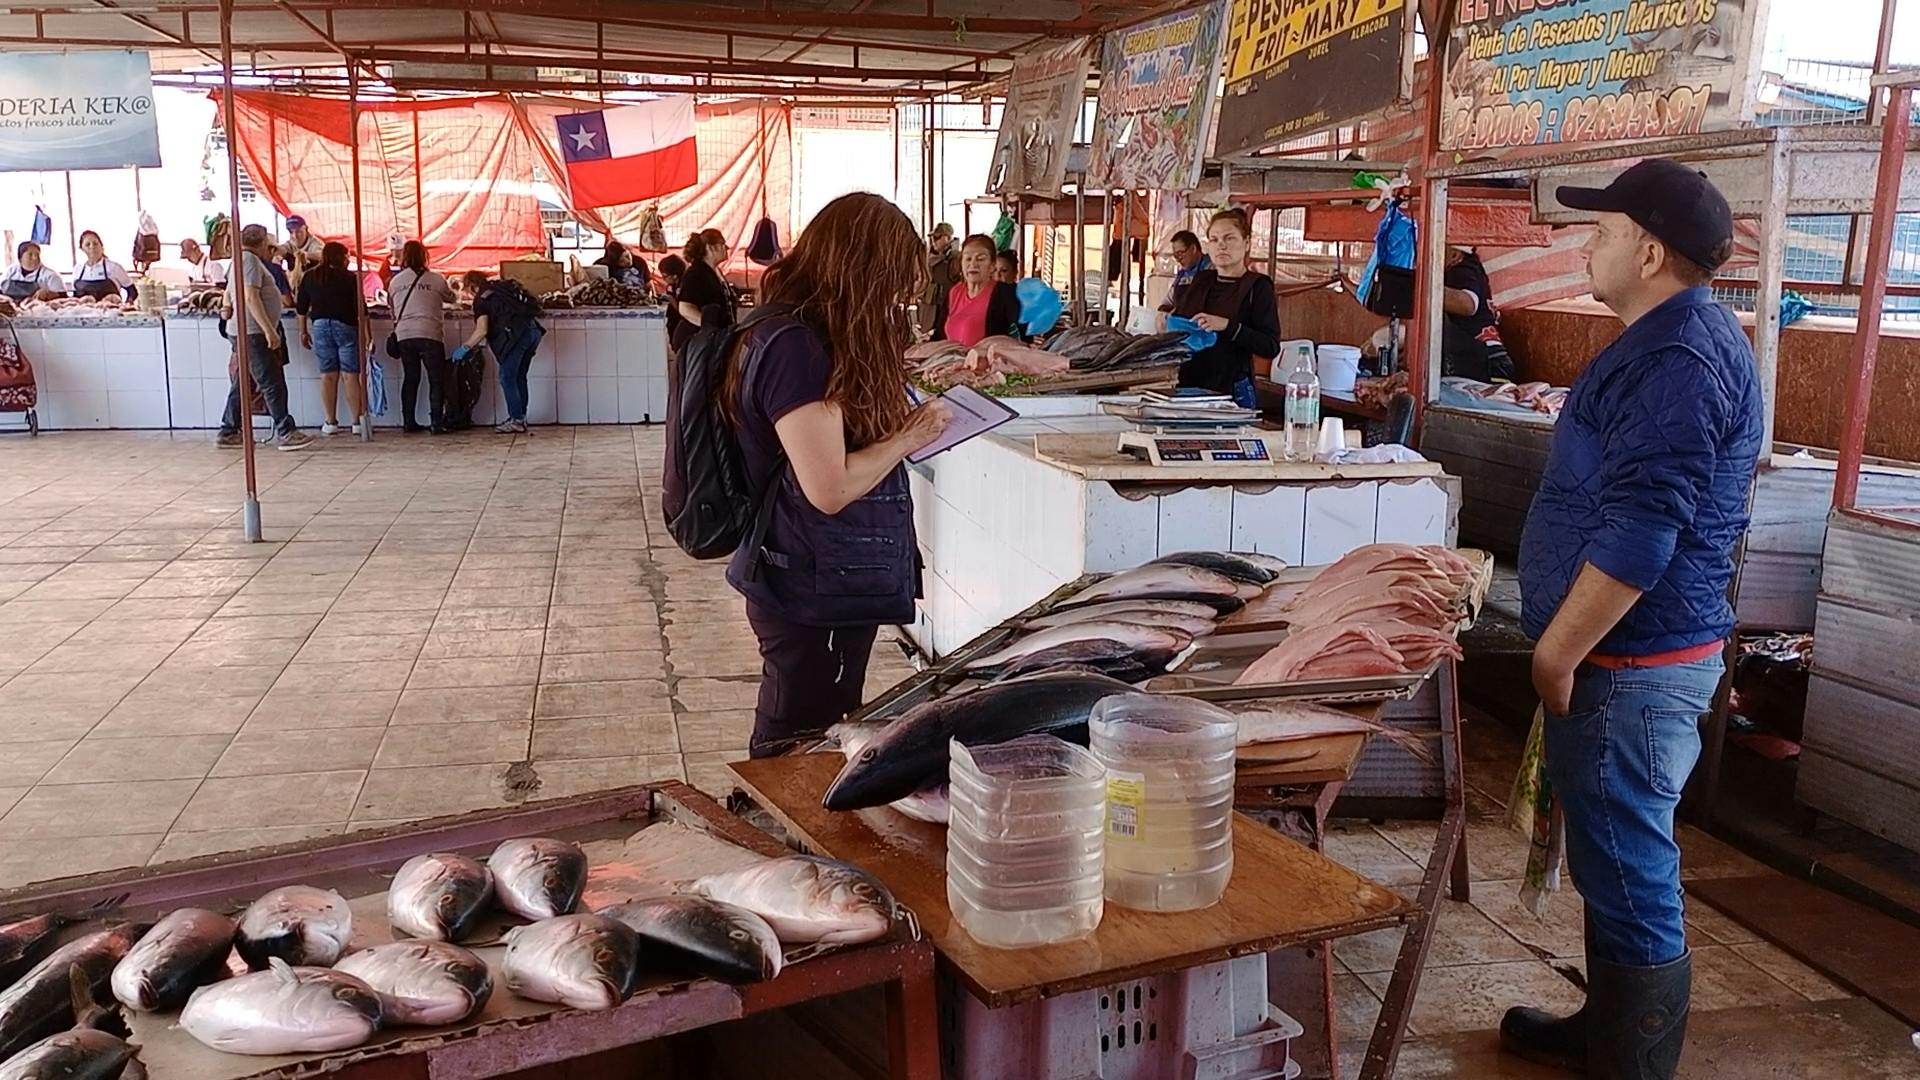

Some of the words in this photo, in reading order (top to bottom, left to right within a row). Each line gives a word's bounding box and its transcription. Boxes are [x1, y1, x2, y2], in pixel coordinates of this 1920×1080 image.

[1308, 41, 1329, 60] JUREL
[1350, 15, 1389, 41] ALBACORA
[1468, 30, 1505, 59] Venta
[1508, 24, 1527, 54] de
[1529, 10, 1605, 51] Pescados
[1606, 10, 1624, 45] y
[1624, 0, 1718, 35] Mariscos
[1490, 65, 1507, 94] Al
[1508, 63, 1536, 93] Por
[1536, 57, 1589, 93] Mayor
[1587, 56, 1605, 90] y
[1604, 47, 1665, 82] Menor
[0, 97, 77, 116] DERIA
[84, 95, 151, 115] KEK@
[25, 117, 63, 129] frescos
[67, 116, 88, 127] del
[90, 118, 117, 127] mar
[1451, 99, 1544, 150] PEDIDOS
